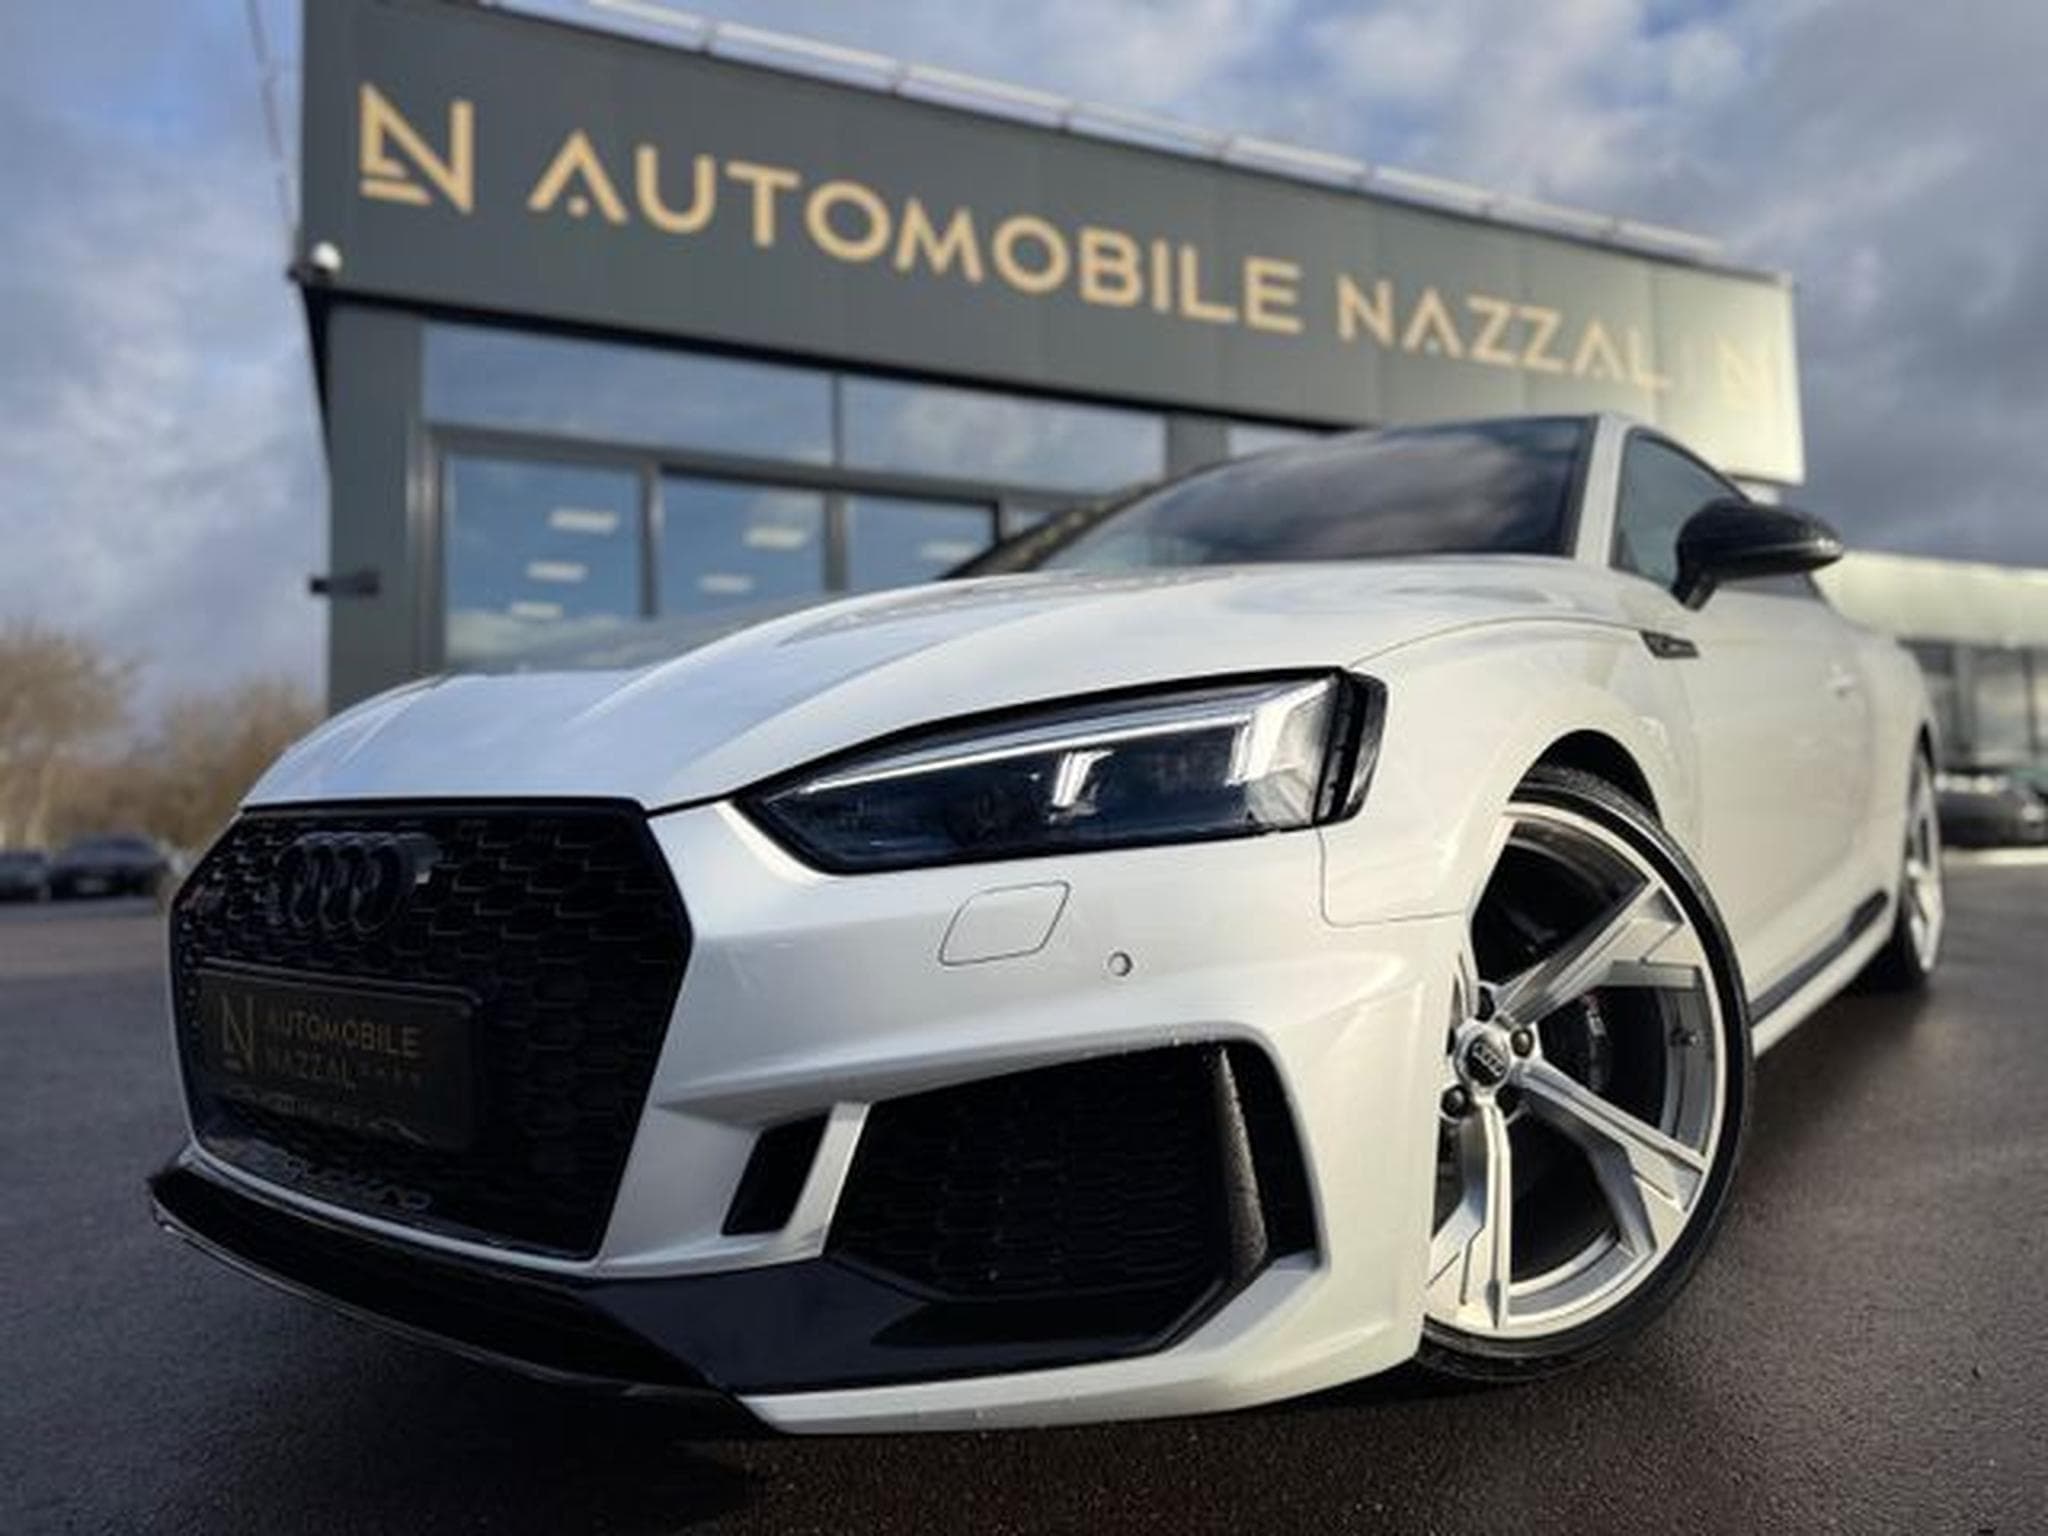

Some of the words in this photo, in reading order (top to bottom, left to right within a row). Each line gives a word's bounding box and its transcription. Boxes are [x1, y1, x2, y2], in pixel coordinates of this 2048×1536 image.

[528, 129, 1304, 334] AUTOMOBILE
[1337, 275, 1671, 392] NAZZAL
[263, 1007, 421, 1059] AUTOMOBILE
